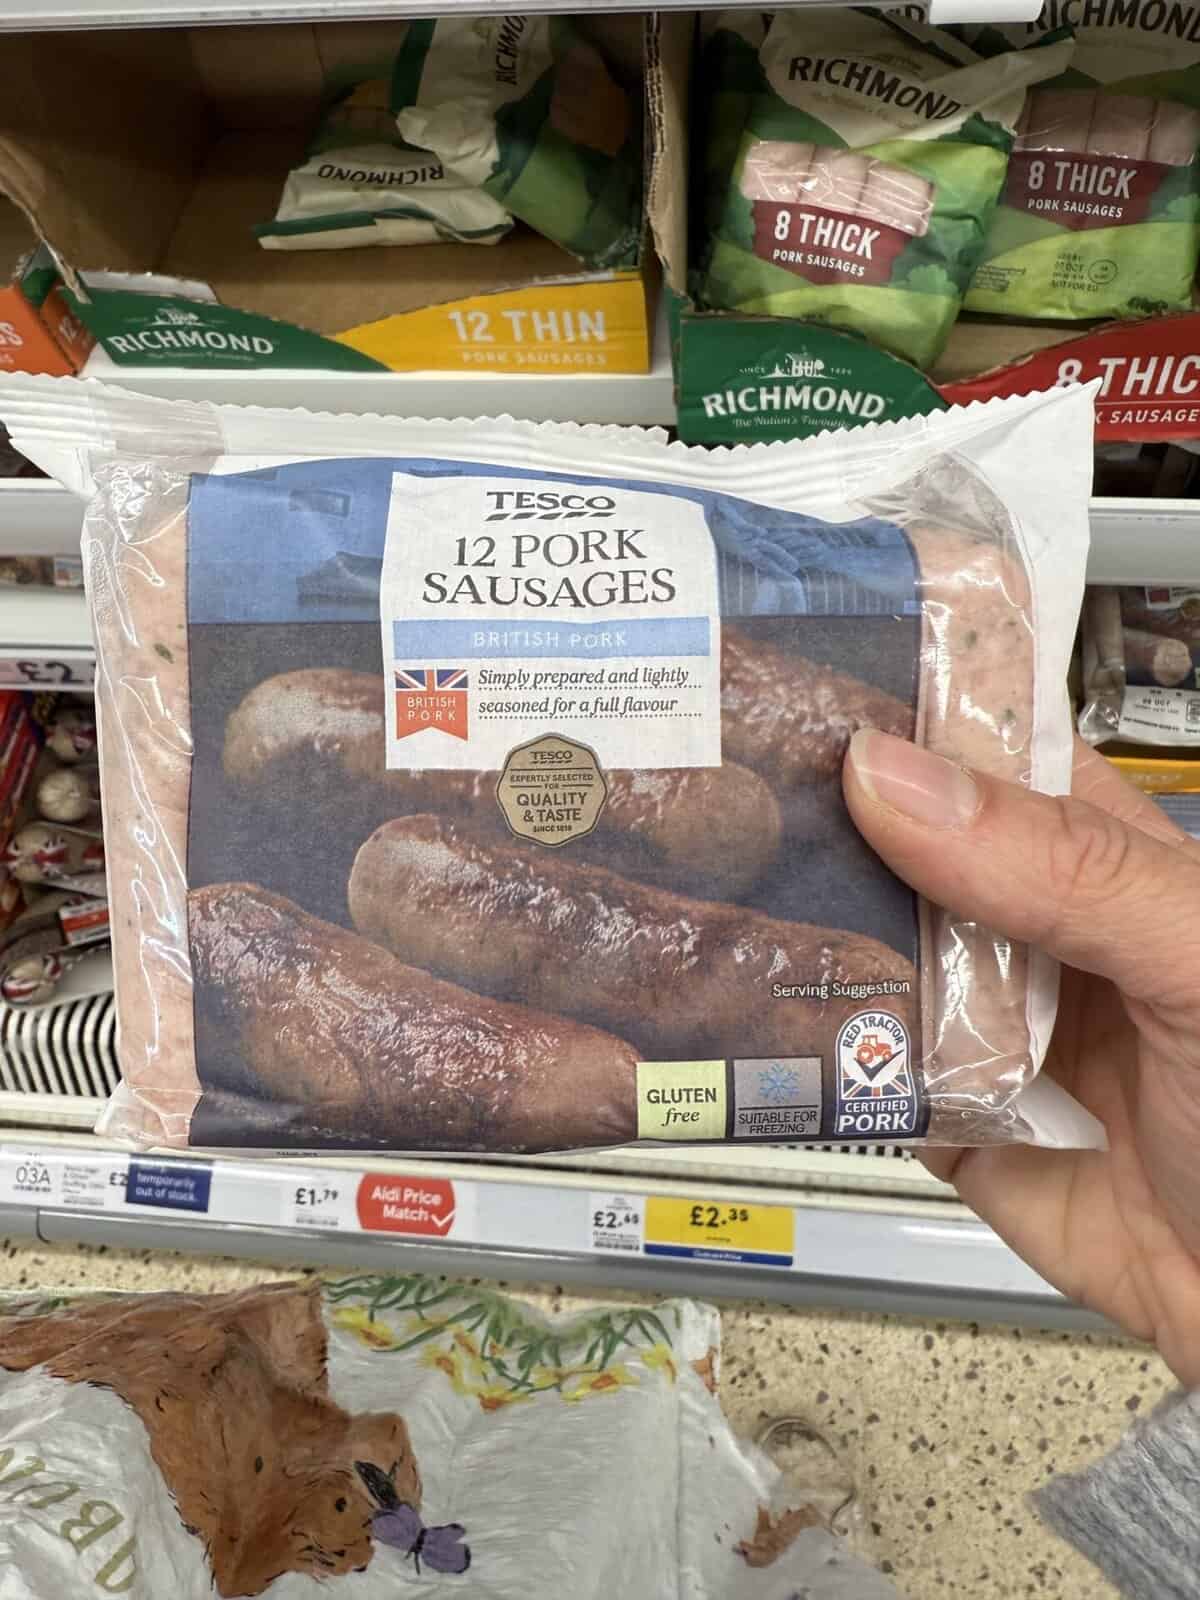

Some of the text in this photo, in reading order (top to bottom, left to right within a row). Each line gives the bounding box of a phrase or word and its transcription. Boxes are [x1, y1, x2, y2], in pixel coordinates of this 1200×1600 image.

[787, 56, 961, 120] RICHMOND
[318, 164, 444, 185] RICHMOND
[1028, 161, 1136, 199] 8 THICK
[1028, 198, 1123, 218] PORK SAUSAGES
[774, 210, 880, 259] 8 THICK
[773, 249, 865, 277] PORK SAUSAGES
[448, 310, 608, 343] 12 THIN
[107, 330, 274, 355] RICHMOND
[463, 351, 608, 365] PORK SAUSAGES
[1055, 355, 1200, 397] 8 THIC
[702, 385, 886, 419] RICHMOND
[485, 491, 616, 514] TESCO
[453, 529, 647, 568] 12 PORK
[422, 568, 676, 608] SAUSAGES
[473, 631, 627, 648] BRITISH PORK
[478, 666, 690, 689] Simply prepared and lightly
[407, 696, 457, 707] BRITISH
[478, 696, 678, 716] seasoned for a full flavour
[408, 710, 457, 721] PORK
[530, 751, 574, 761] TESCO
[510, 773, 594, 783] EXPERTLY SELECTED
[516, 792, 588, 806] QUALITY
[523, 808, 582, 823] & TASTE
[533, 825, 555, 833] SINCE
[772, 981, 911, 999] Serving Suggestion
[842, 1015, 904, 1048] RED TRACTOR
[647, 1088, 717, 1104] GLUTEN
[661, 1107, 700, 1126] free
[845, 1101, 908, 1113] CERTIFIED
[739, 1110, 817, 1125] SUITABLE FOR
[838, 1112, 911, 1132] PORK
[750, 1123, 805, 1134] FREEZING
[16, 1166, 51, 1184] 03A
[137, 1172, 196, 1190] temporarily
[295, 1188, 338, 1206] £1.79
[372, 1186, 442, 1205] Aldi Price
[383, 1205, 429, 1221] Match
[689, 1205, 749, 1229] £2.35
